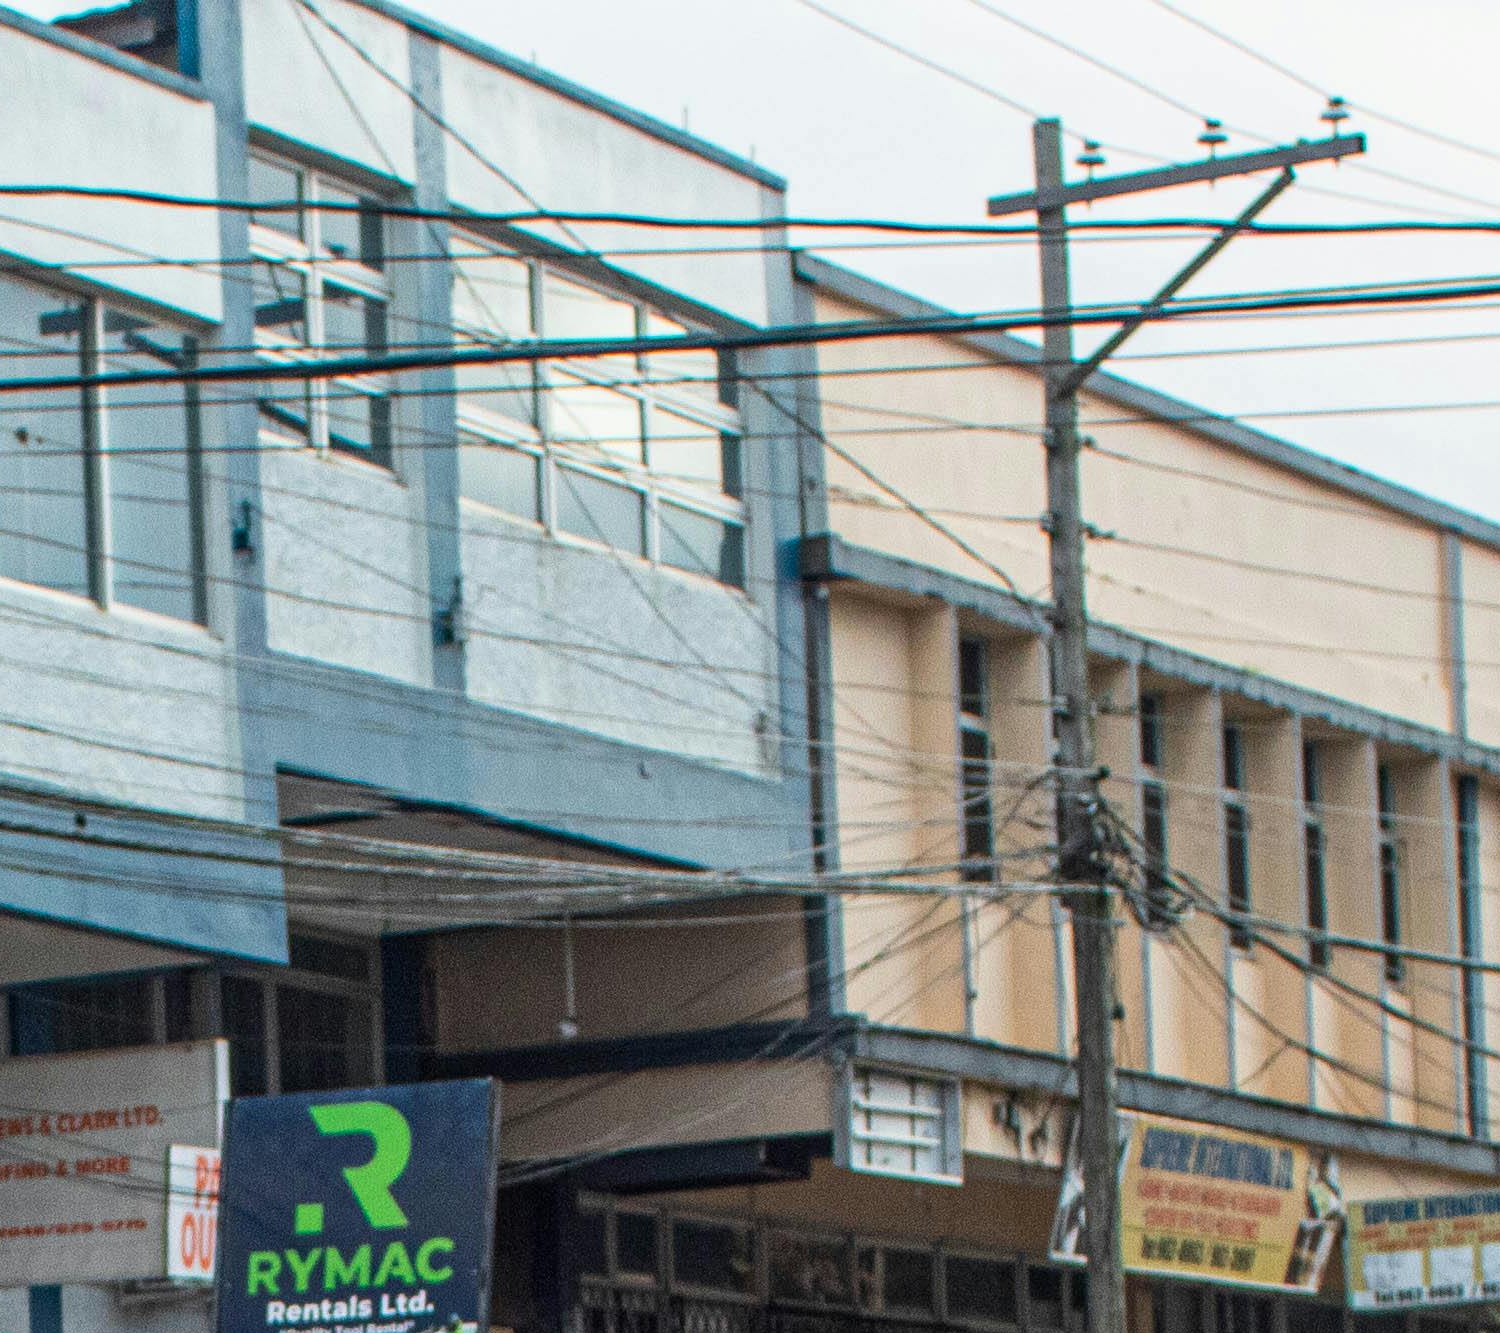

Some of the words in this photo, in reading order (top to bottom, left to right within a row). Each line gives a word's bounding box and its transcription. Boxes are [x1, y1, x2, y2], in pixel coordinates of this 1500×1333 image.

[247, 1237, 455, 1296] RYMAC
[266, 1295, 373, 1325] Rentals
[379, 1289, 435, 1317] Ltd.
